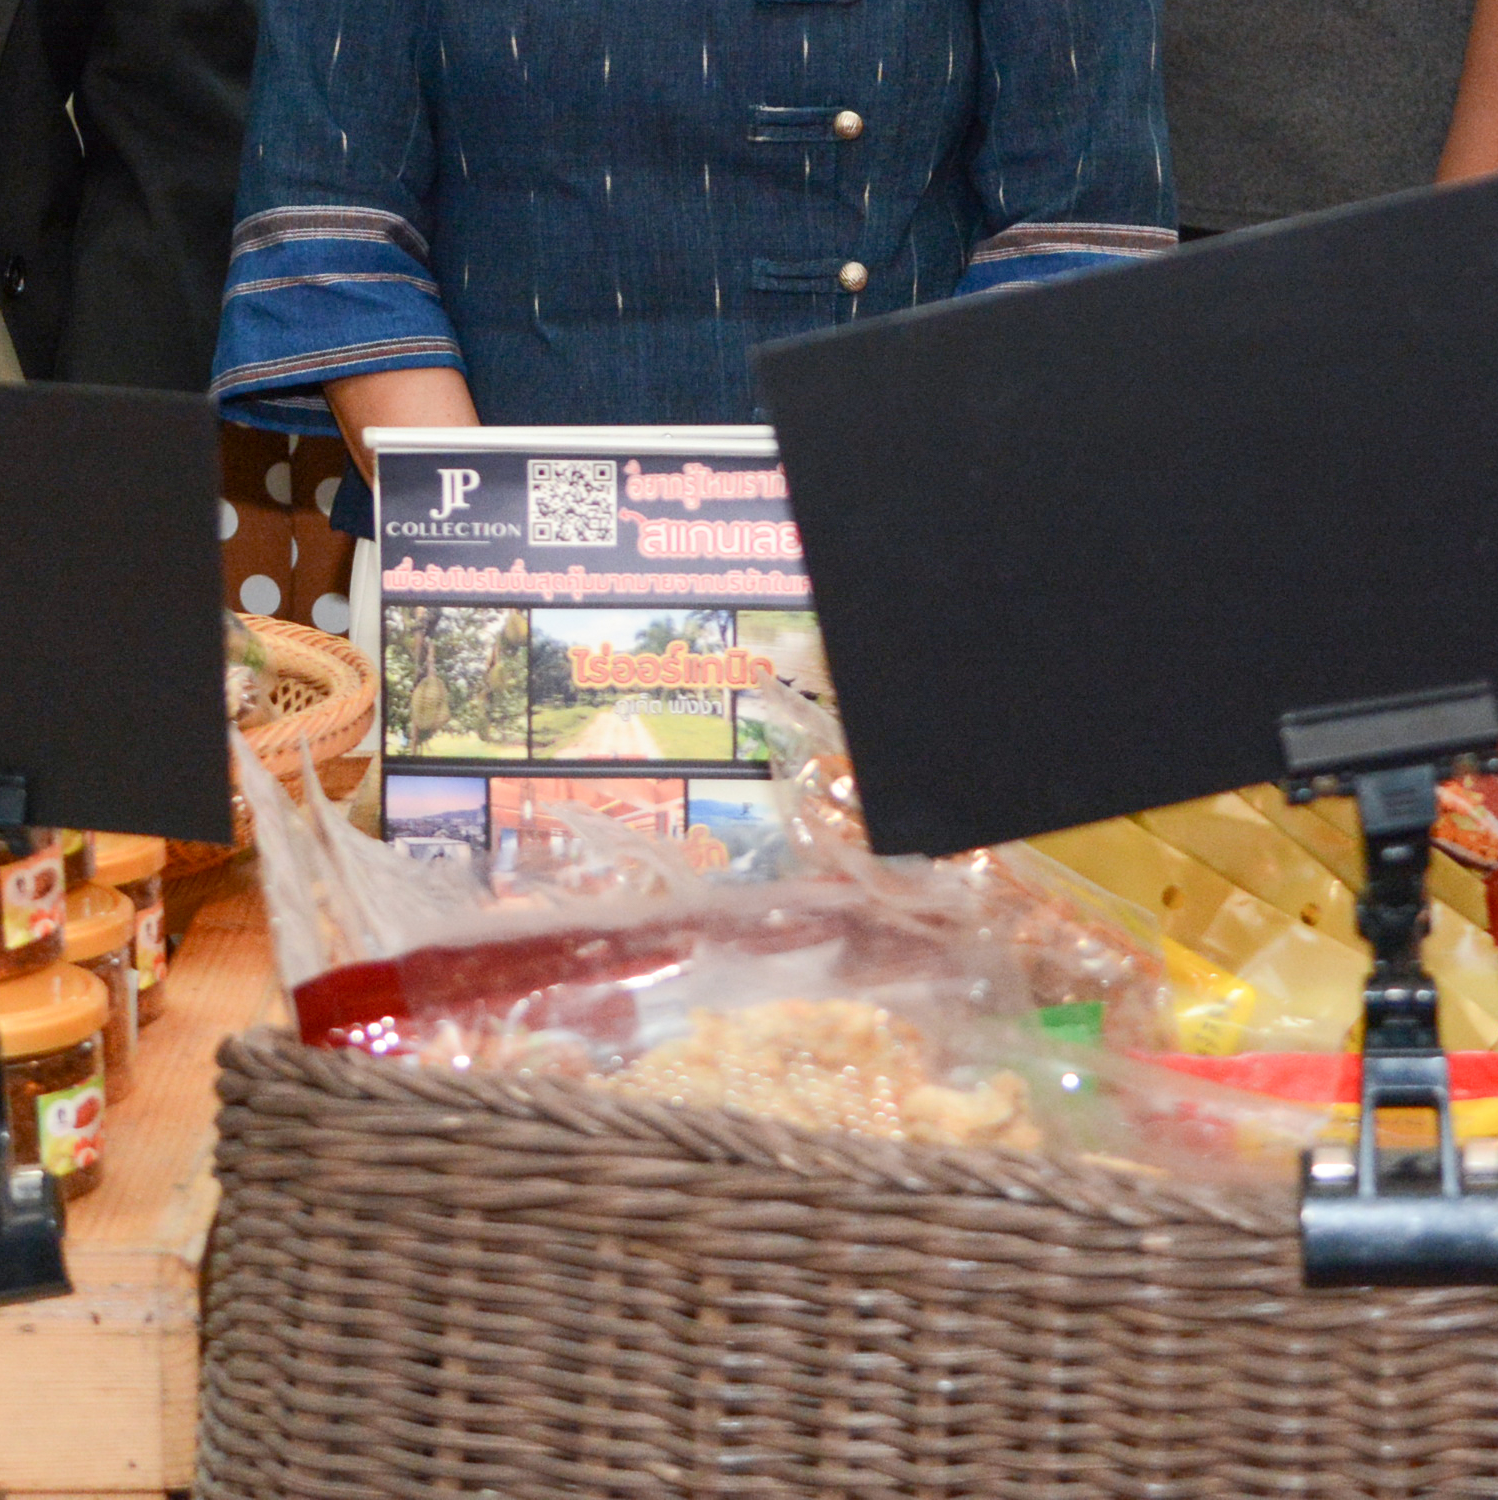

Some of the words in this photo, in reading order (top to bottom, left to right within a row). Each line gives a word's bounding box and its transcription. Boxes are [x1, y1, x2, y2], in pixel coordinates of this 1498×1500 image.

[429, 468, 481, 520] JP
[385, 521, 521, 537] COLLECTION
[639, 520, 803, 558] สแกนเลย
